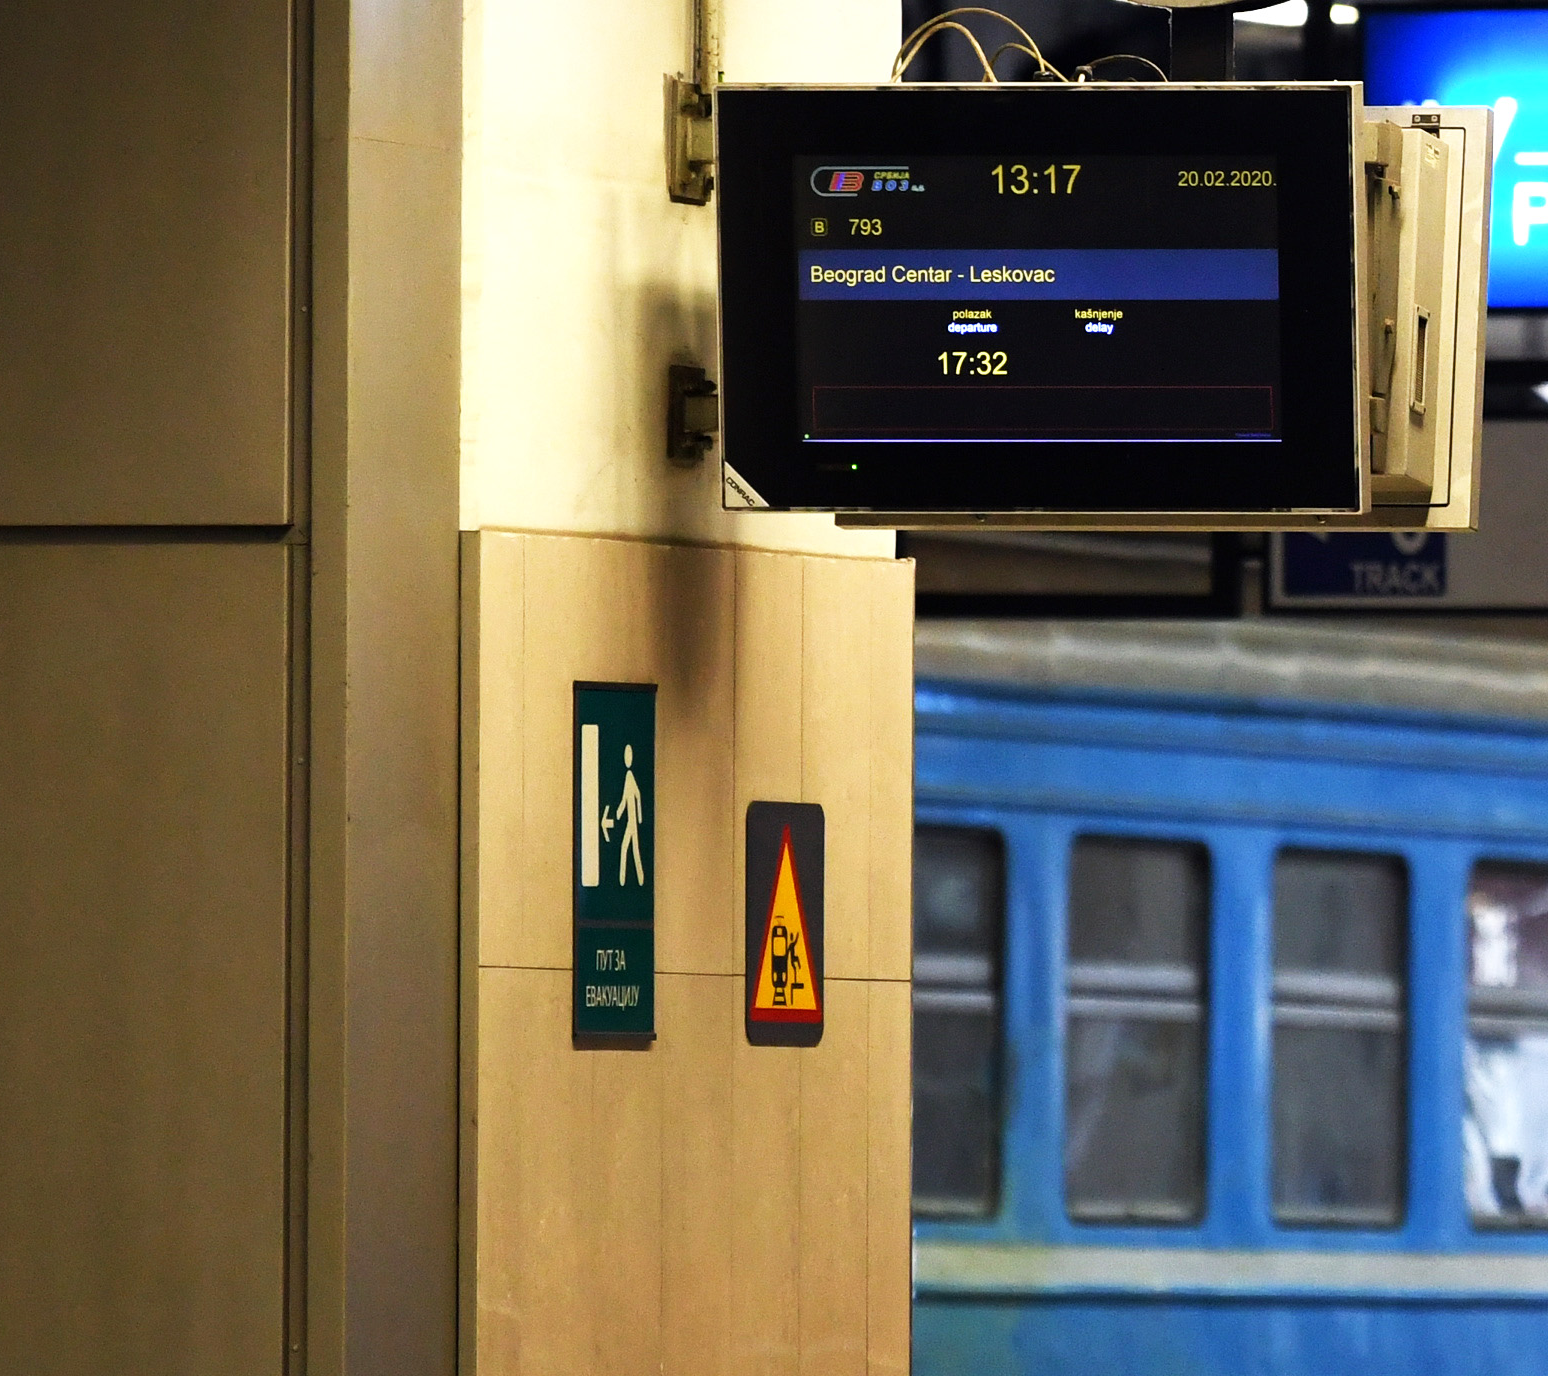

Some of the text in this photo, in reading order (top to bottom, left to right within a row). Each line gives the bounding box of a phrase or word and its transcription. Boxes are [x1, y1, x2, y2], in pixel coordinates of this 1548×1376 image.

[990, 163, 1082, 195] 13:17
[1177, 170, 1278, 187] 20.02.2020.
[848, 219, 883, 236] 793
[810, 265, 886, 287] Beograd
[891, 265, 952, 283] Centar
[969, 265, 1056, 283] Leskovac
[952, 309, 993, 321] polazak
[1074, 308, 1124, 321] kašnjenje
[947, 322, 999, 336] departure
[1084, 322, 1114, 336] delay
[937, 351, 1008, 376] 17:32
[725, 476, 756, 507] CONRAC
[595, 949, 626, 971] ПУТ ЗА
[585, 985, 640, 1012] ЕВАКУАЦИЈУ
